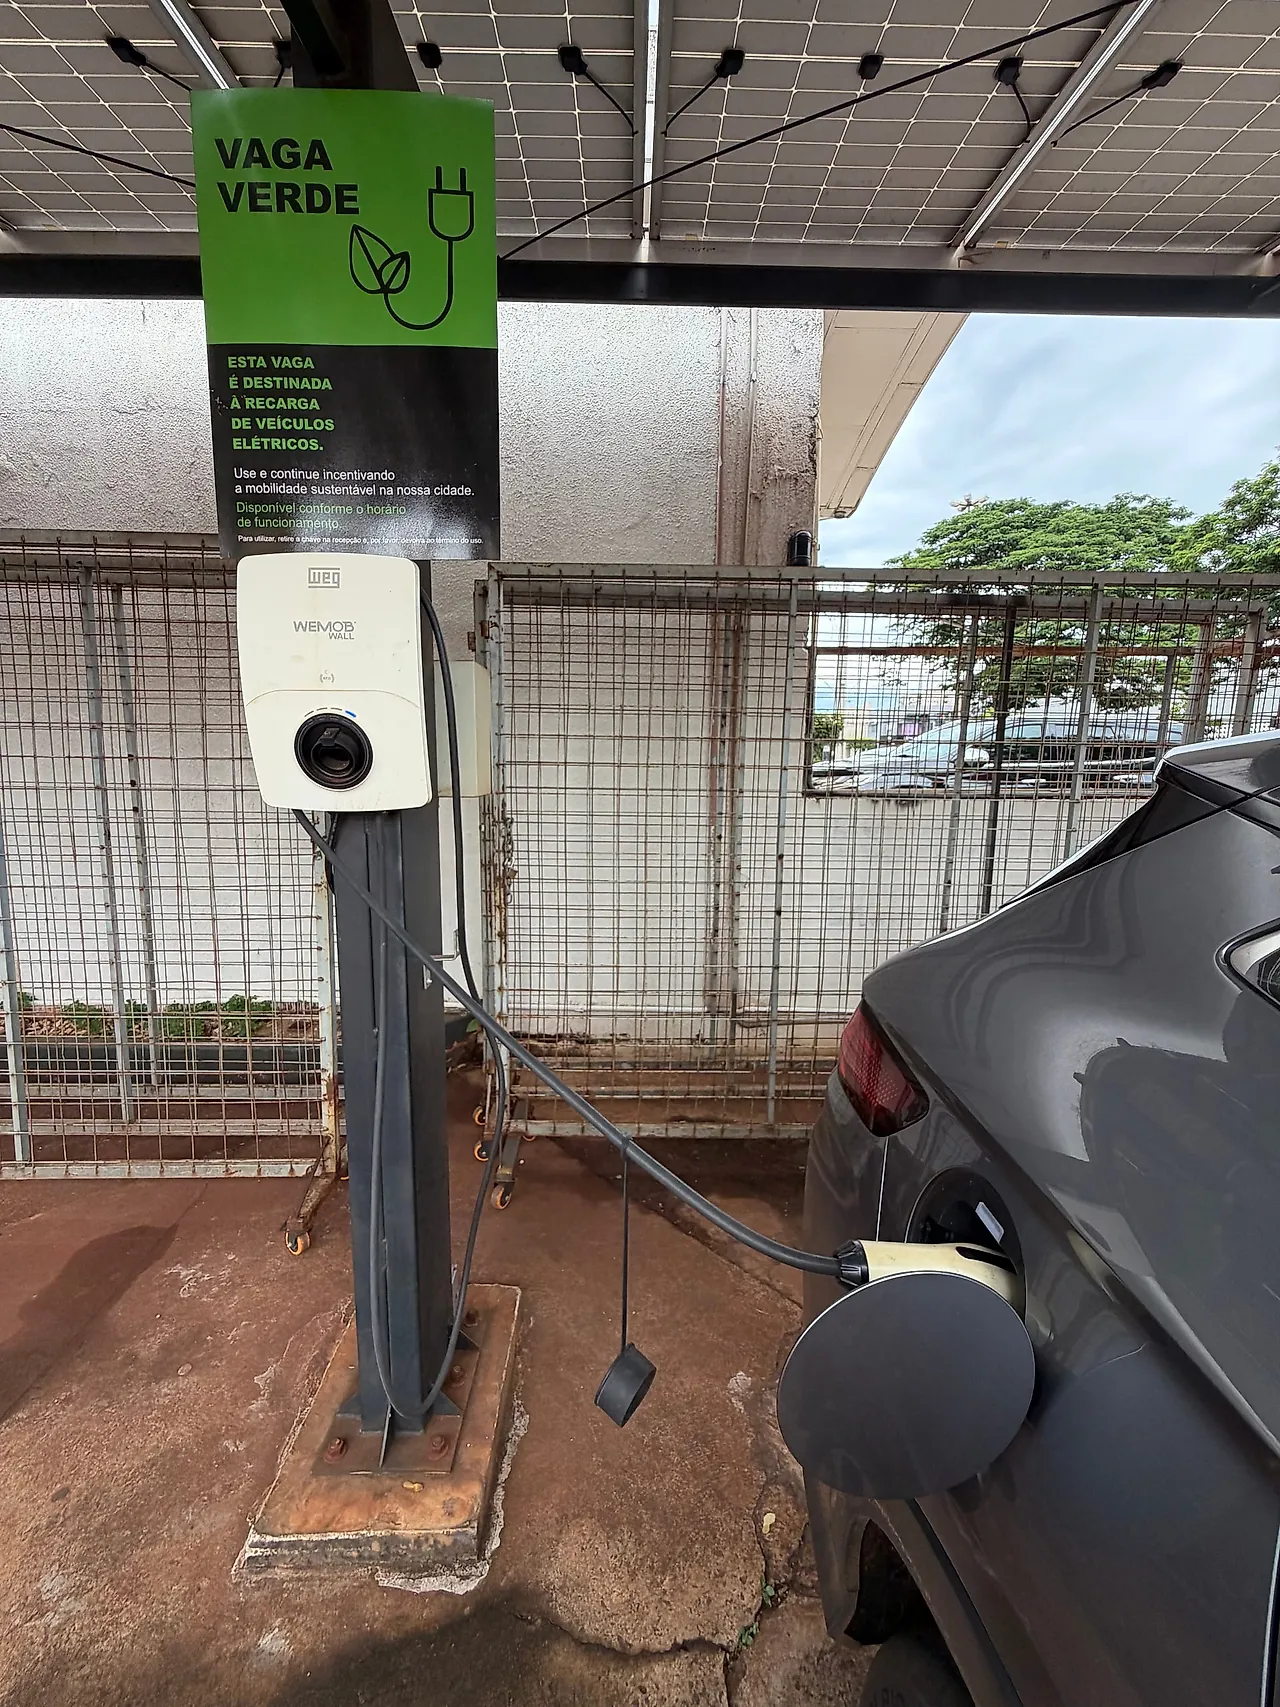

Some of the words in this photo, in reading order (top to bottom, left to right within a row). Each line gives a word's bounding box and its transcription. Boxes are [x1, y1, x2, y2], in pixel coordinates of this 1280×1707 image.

[214, 138, 333, 170] VAGA
[216, 182, 360, 215] VERDE
[227, 356, 267, 369] ESTA
[270, 356, 315, 369] VAGA
[229, 374, 239, 389] É
[243, 376, 333, 390] DESTINADA
[230, 395, 241, 410] À
[245, 397, 320, 410] RECARGA
[231, 418, 252, 430] DE
[255, 416, 335, 431] VEÍCULOS
[232, 435, 324, 451] ELÉTRICOS.
[234, 467, 257, 479] Use
[260, 469, 267, 479] e
[270, 468, 320, 480] continue
[323, 469, 396, 481] incentivando
[235, 485, 242, 494] a
[245, 482, 308, 494] mobilidade
[311, 484, 376, 496] sustentável
[379, 487, 394, 496] na
[397, 487, 431, 496] nossa
[433, 485, 475, 496] cidade.
[236, 502, 296, 515] Disponível
[299, 503, 353, 515] conforme
[356, 506, 364, 515] o
[366, 503, 407, 515] horário
[237, 517, 251, 528] de
[238, 534, 253, 542] Para
[278, 535, 295, 543] retire
[302, 535, 320, 543] chave
[329, 632, 355, 640] WALL
